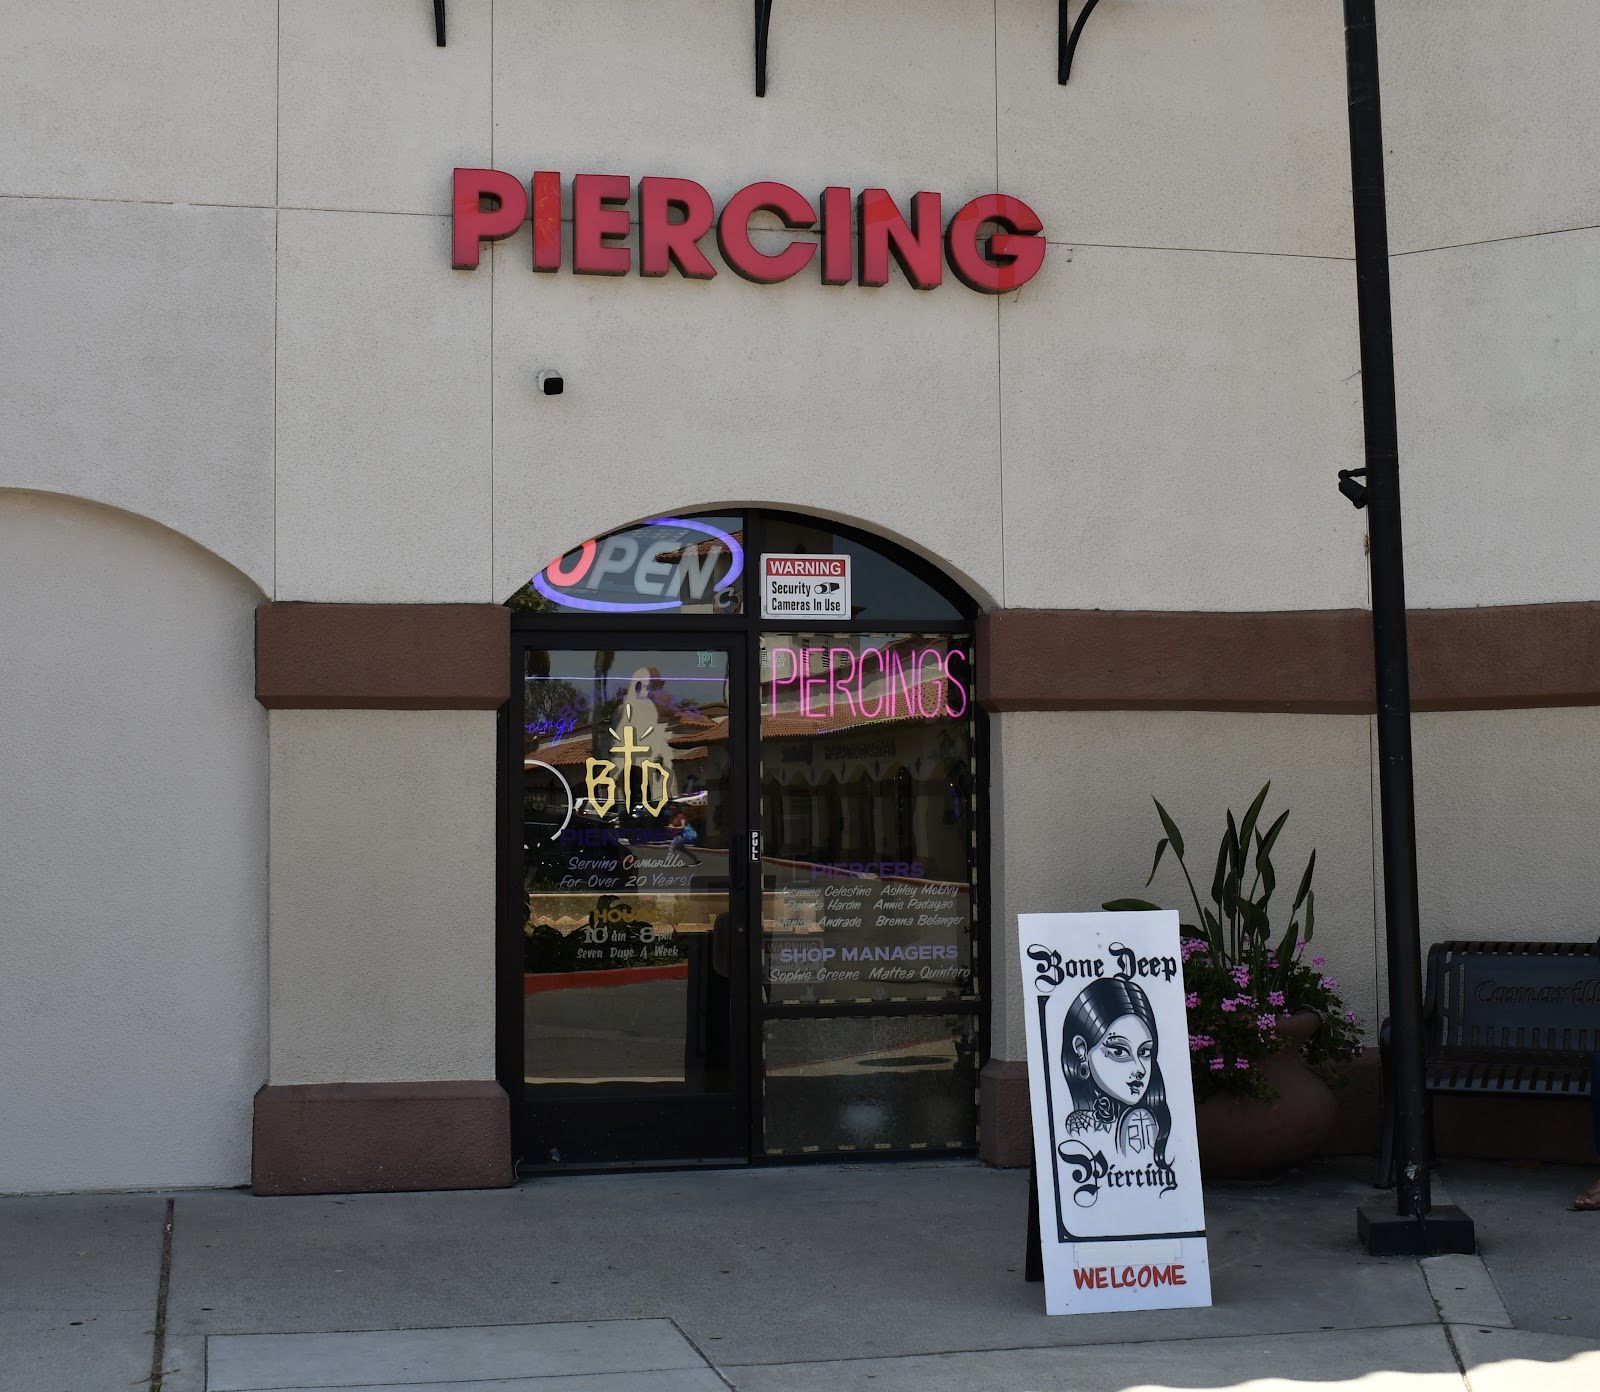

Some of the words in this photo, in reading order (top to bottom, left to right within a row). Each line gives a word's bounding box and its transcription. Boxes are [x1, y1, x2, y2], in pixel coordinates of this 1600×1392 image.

[452, 168, 1046, 294] PIERCING
[547, 537, 723, 600] OPEN
[769, 561, 842, 575] WARNING
[771, 581, 811, 597] Security
[771, 597, 811, 611] Cameras
[813, 598, 822, 611] In
[825, 599, 842, 611] Use
[771, 648, 967, 718] PIERCINGS
[751, 831, 759, 861] PULL
[568, 856, 618, 872] Serving
[622, 855, 686, 870] Camarillo
[811, 861, 926, 880] PIERCERS
[560, 875, 582, 889] For
[587, 875, 620, 888] Over
[625, 875, 648, 887] 20
[652, 873, 695, 888] Years!
[824, 885, 873, 897] Celestine
[880, 884, 918, 898] Ashley
[827, 898, 862, 911] Hardin
[873, 899, 904, 911] Annie
[817, 916, 863, 928] Andrade
[875, 915, 914, 927] Brenna
[917, 914, 966, 928] Belanger
[583, 926, 609, 944] 10
[640, 926, 656, 943] 8
[577, 948, 603, 959] Seven
[609, 947, 635, 960] Days
[640, 946, 648, 959] A
[654, 946, 678, 957] Week
[780, 948, 837, 963] SHOP
[841, 945, 959, 962] MANAGERS
[770, 968, 813, 984] Sophie
[816, 967, 860, 981] Greene
[868, 966, 916, 980] Mattea
[919, 965, 972, 980] Quintero
[1027, 943, 1105, 993] Bone
[1108, 941, 1178, 983] Deep
[1058, 1139, 1178, 1207] Piercing
[1073, 1264, 1188, 1290] WELCOME
